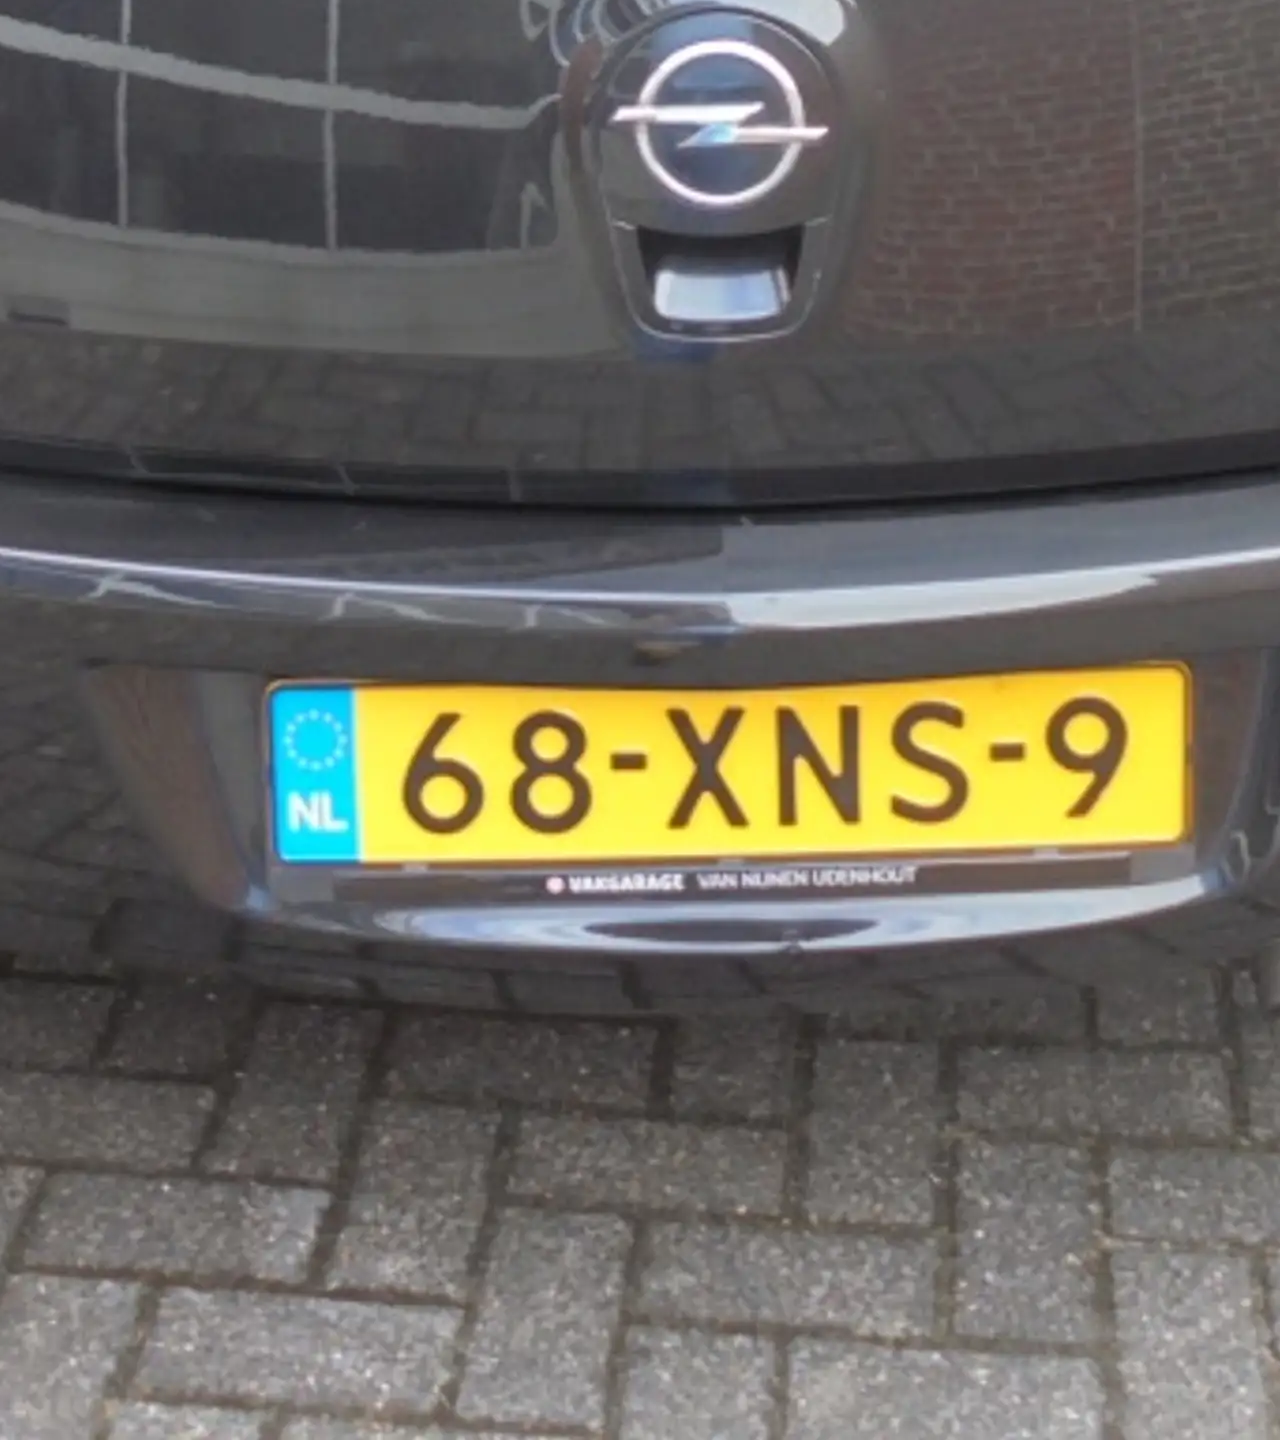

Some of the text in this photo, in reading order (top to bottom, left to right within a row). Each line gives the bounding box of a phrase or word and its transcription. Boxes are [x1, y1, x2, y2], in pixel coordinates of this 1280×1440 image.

[401, 696, 1131, 835] 68-XNS-9
[287, 791, 349, 834] NL
[696, 871, 738, 890] VAN
[812, 865, 918, 887] UDENHOUT
